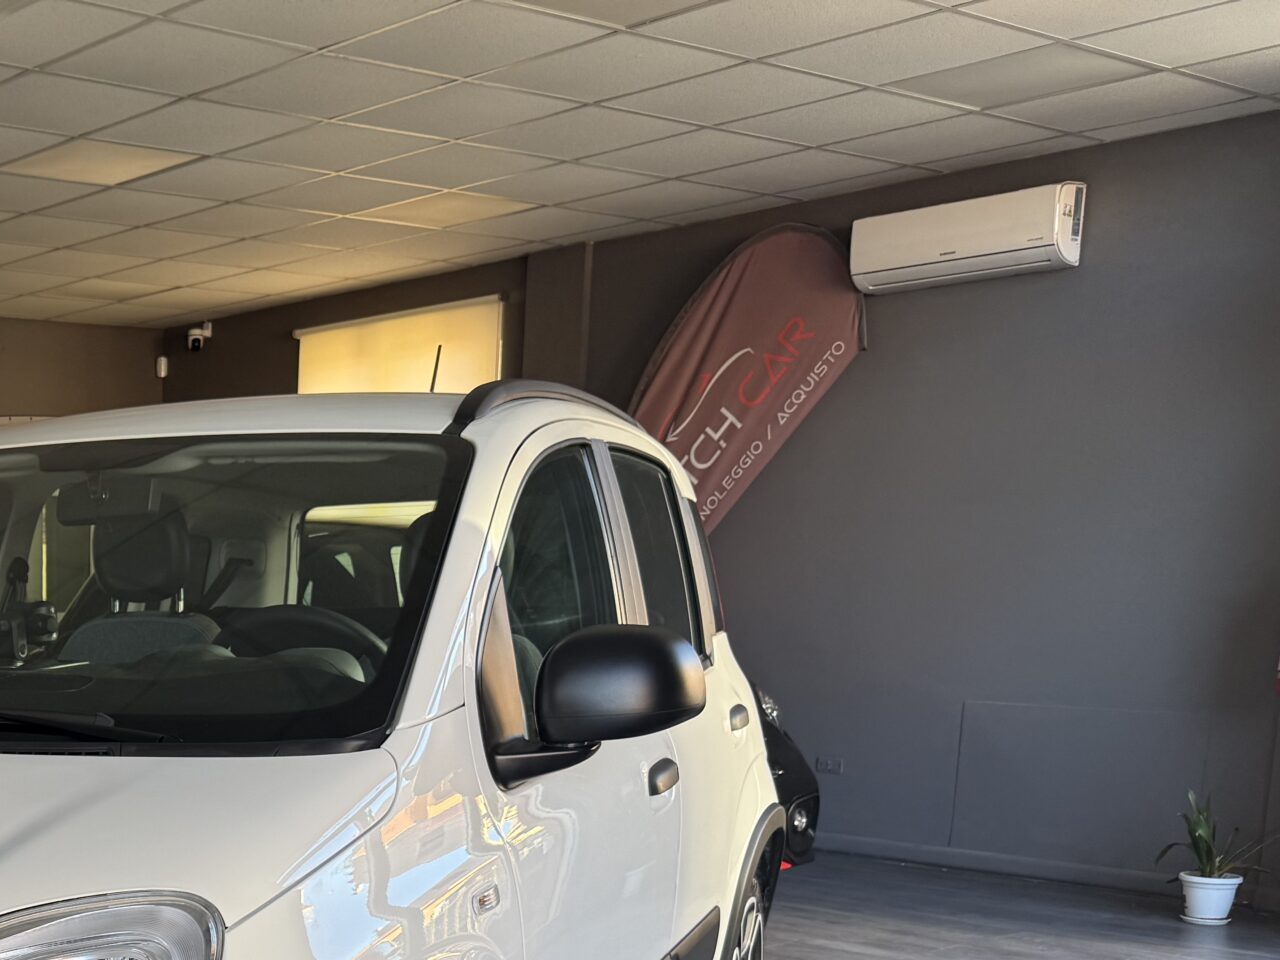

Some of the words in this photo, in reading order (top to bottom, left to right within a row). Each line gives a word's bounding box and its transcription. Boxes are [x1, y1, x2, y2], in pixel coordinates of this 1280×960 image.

[737, 317, 816, 408] CAR
[700, 440, 762, 520] NOLEGGIO
[777, 341, 845, 425] ACQUISTO
